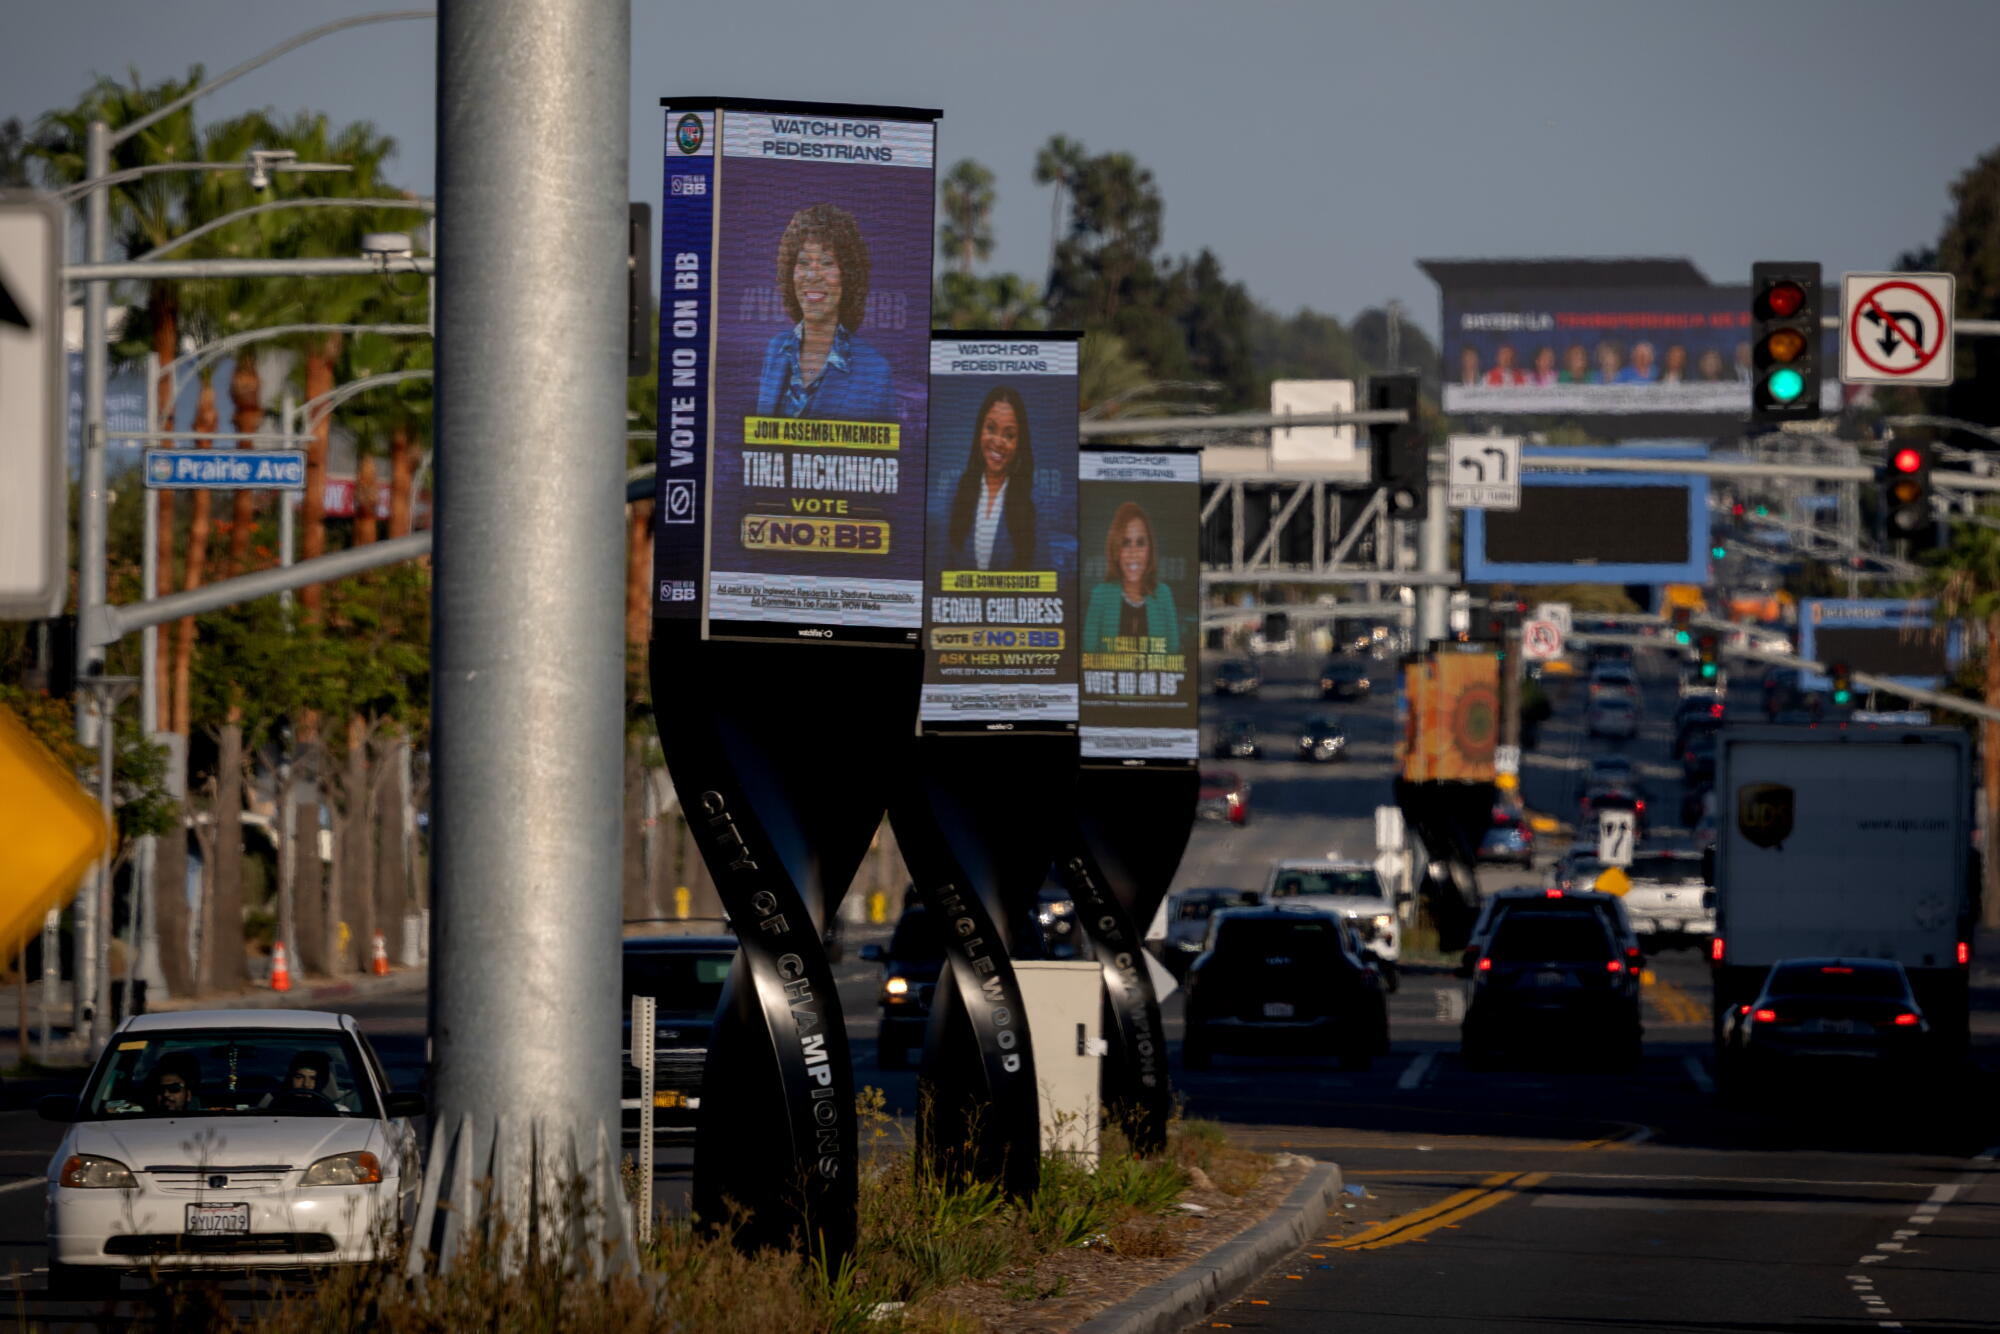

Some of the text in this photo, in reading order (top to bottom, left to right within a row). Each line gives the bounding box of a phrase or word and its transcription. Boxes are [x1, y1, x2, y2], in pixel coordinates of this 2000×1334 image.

[771, 119, 881, 139] WATCH FOR
[762, 140, 893, 161] PEDESTRIANS
[670, 251, 699, 468] VOTE NO ON BB
[958, 343, 1039, 356] WATCH FOR
[952, 360, 1048, 372] PEDESTRIANS
[754, 420, 890, 445] JOIN ASSEMBLYMEMBER
[175, 457, 301, 481] Prairie Ave
[742, 451, 785, 488] TINA
[791, 453, 899, 494] MCKINNOR
[1095, 468, 1175, 479] PEDESTRIANS
[791, 498, 849, 514] VOTE
[769, 522, 816, 546] NO
[834, 524, 882, 550] BB
[976, 575, 1040, 588] COMMISSIONER
[671, 588, 696, 601] BB
[985, 597, 1064, 624] CHILDRESS
[935, 634, 968, 643] VOTE
[986, 630, 1016, 646] NO
[1027, 631, 1059, 647] BB
[939, 653, 1060, 665] ASK HER WHY???
[702, 790, 841, 1179] CITY OF CHAMPIONS
[937, 883, 1021, 1073] INGLEWOOD
